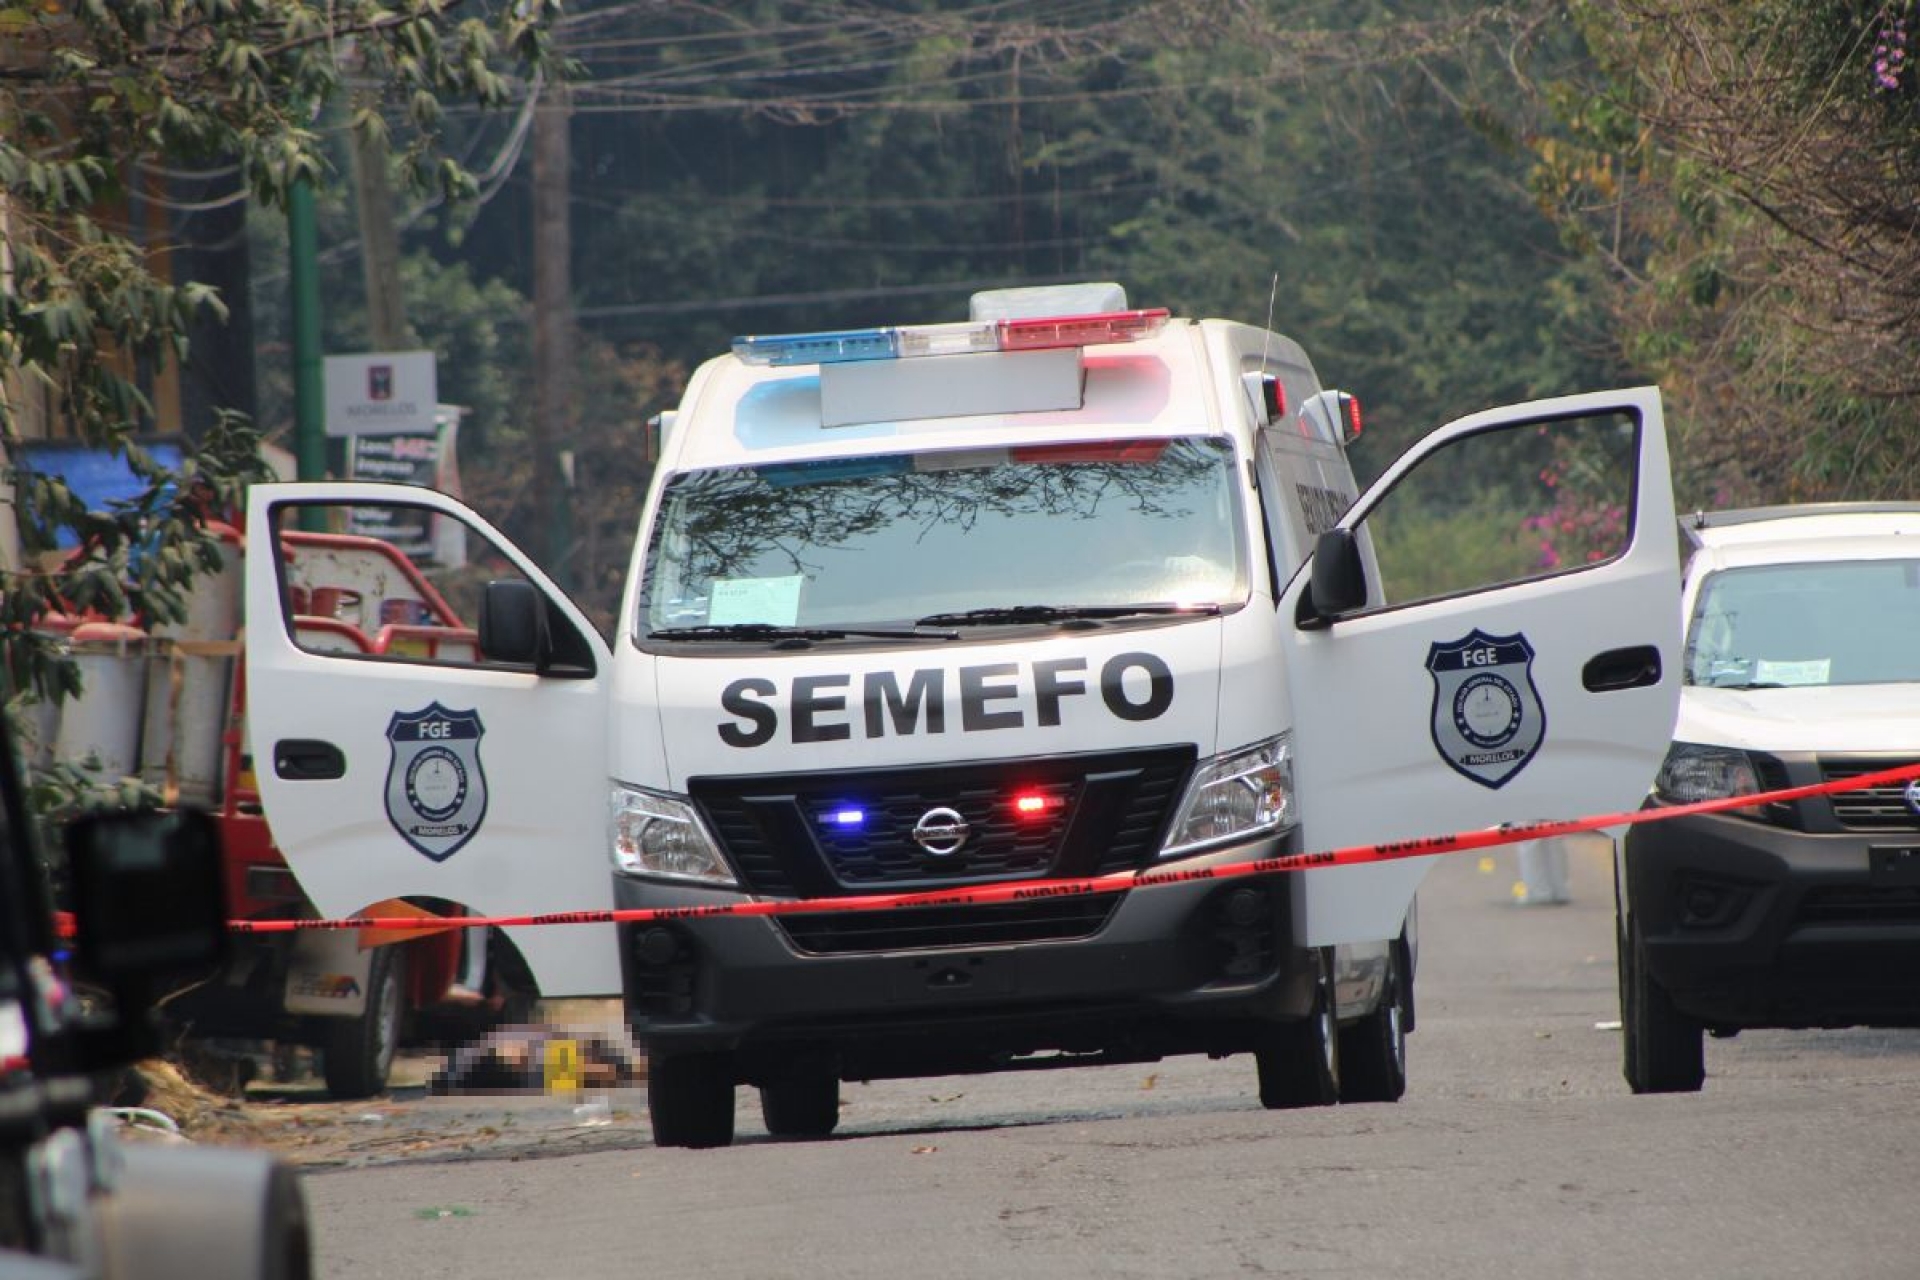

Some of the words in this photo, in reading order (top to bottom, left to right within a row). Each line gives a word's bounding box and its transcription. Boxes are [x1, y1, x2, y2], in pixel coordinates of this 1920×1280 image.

[1461, 647, 1498, 667] FGE
[718, 651, 1174, 748] SEMEFO
[418, 721, 452, 739] FGE
[1469, 750, 1516, 764] MORELOS
